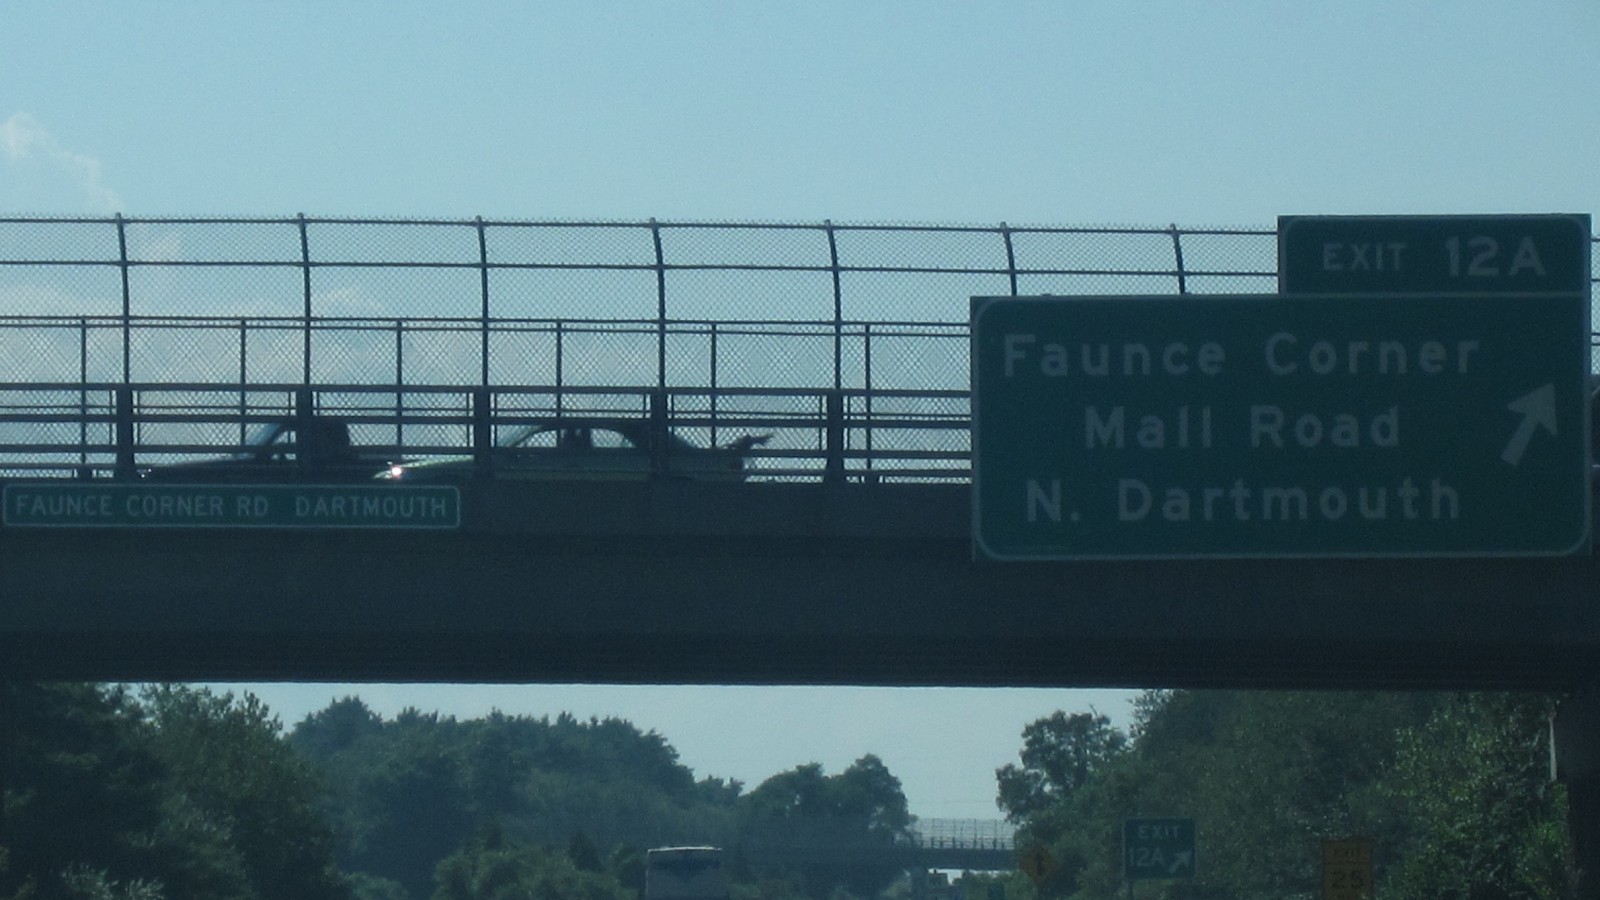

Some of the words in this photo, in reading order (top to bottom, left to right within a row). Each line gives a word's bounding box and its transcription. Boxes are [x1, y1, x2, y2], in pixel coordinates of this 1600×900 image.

[1322, 241, 1406, 272] EXIT
[1445, 235, 1547, 277] 12A
[1003, 333, 1227, 377] Faunce
[1265, 332, 1481, 376] Corner
[1084, 405, 1212, 449] Mall
[1250, 404, 1401, 449] Road
[15, 494, 113, 518] FAUNCE
[125, 494, 225, 519] CORNER
[237, 495, 270, 519] RD
[294, 495, 448, 520] DARTMOUTH
[1026, 479, 1081, 523] N.
[1117, 477, 1461, 523] Dartmouth
[1137, 824, 1181, 840] EXIT
[1128, 847, 1167, 868] 12A
